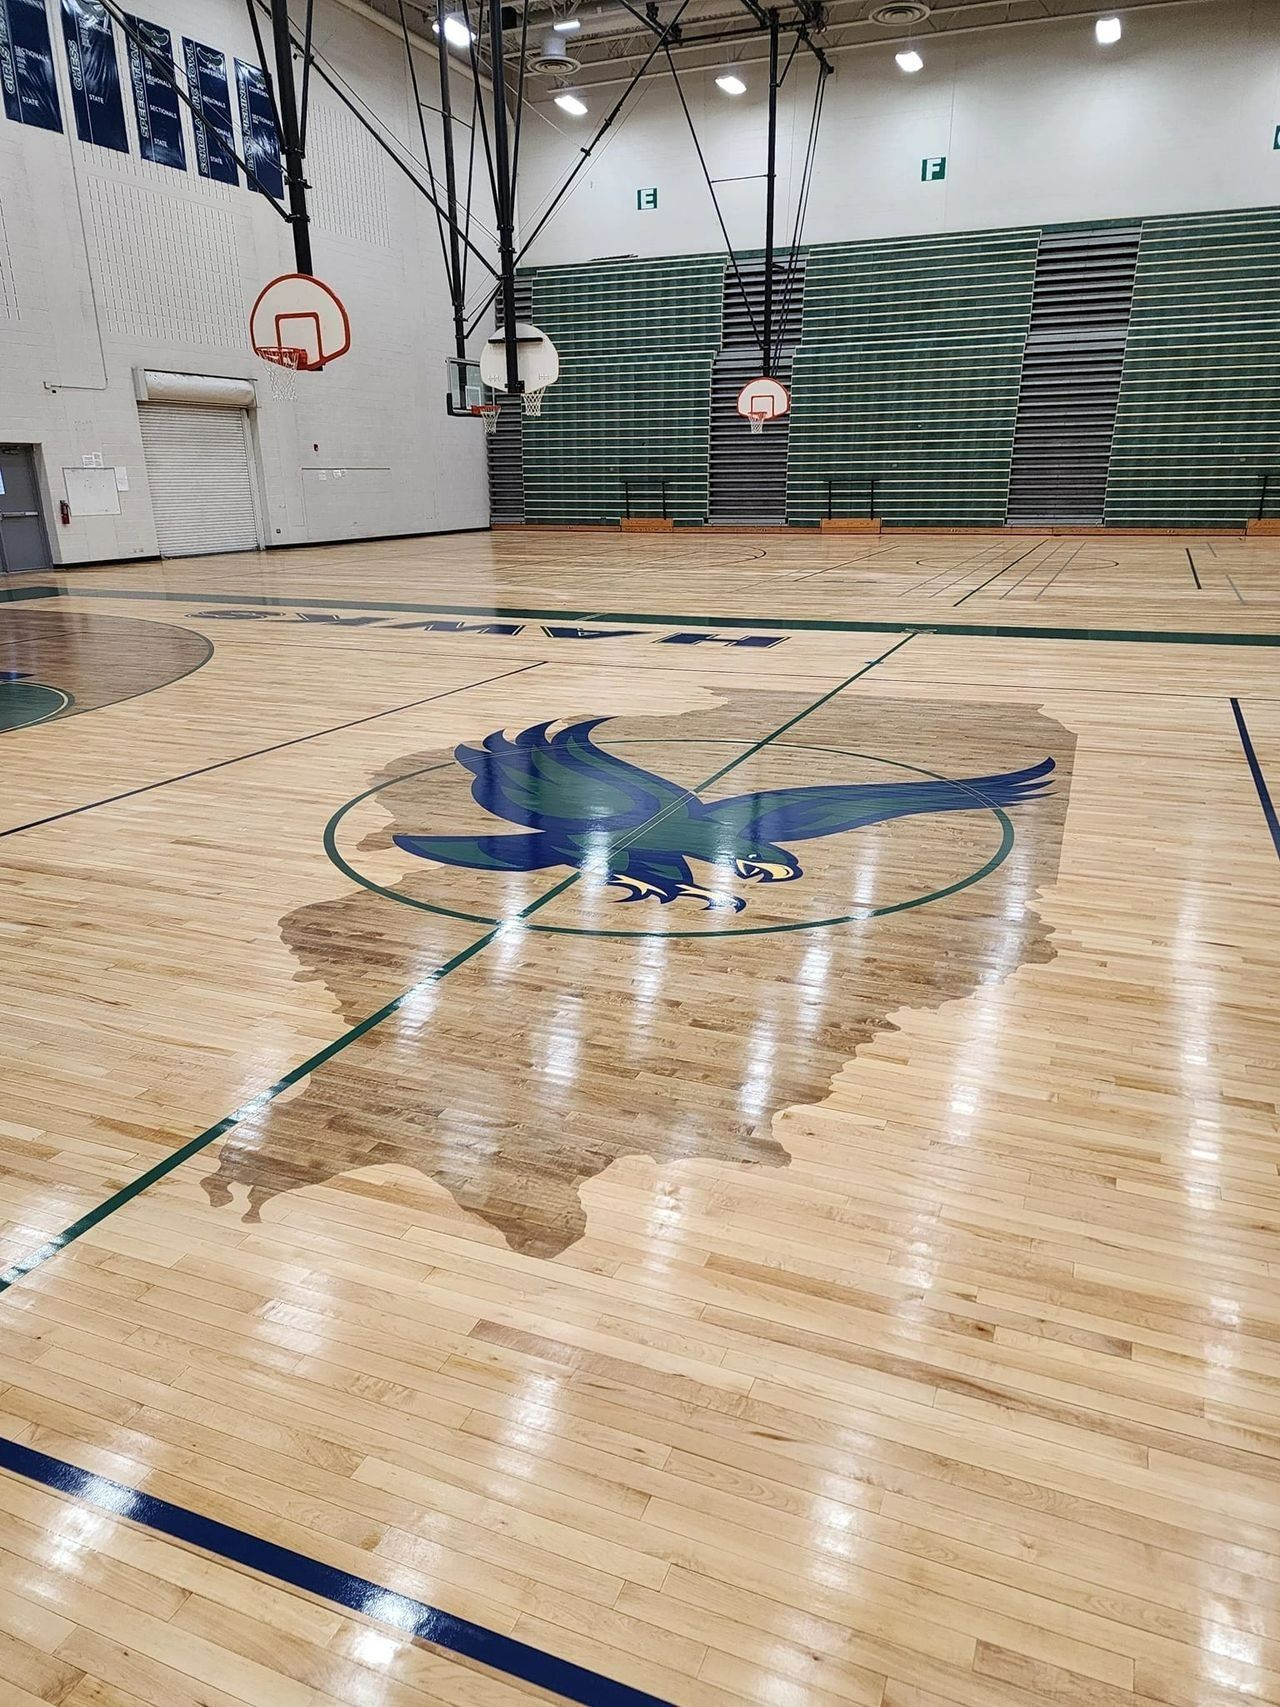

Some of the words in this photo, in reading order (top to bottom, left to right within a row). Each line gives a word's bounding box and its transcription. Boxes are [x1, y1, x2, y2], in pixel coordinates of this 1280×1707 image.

[67, 39, 83, 90] CHESS
[22, 96, 40, 107] STATE
[89, 94, 104, 104] STATE
[239, 81, 250, 135] FISHING
[134, 81, 149, 138] SPEECH
[149, 104, 178, 119] SECTIONALS
[153, 138, 168, 147] STATE
[210, 156, 223, 165] STATE
[924, 157, 943, 181] F
[640, 188, 656, 210] E
